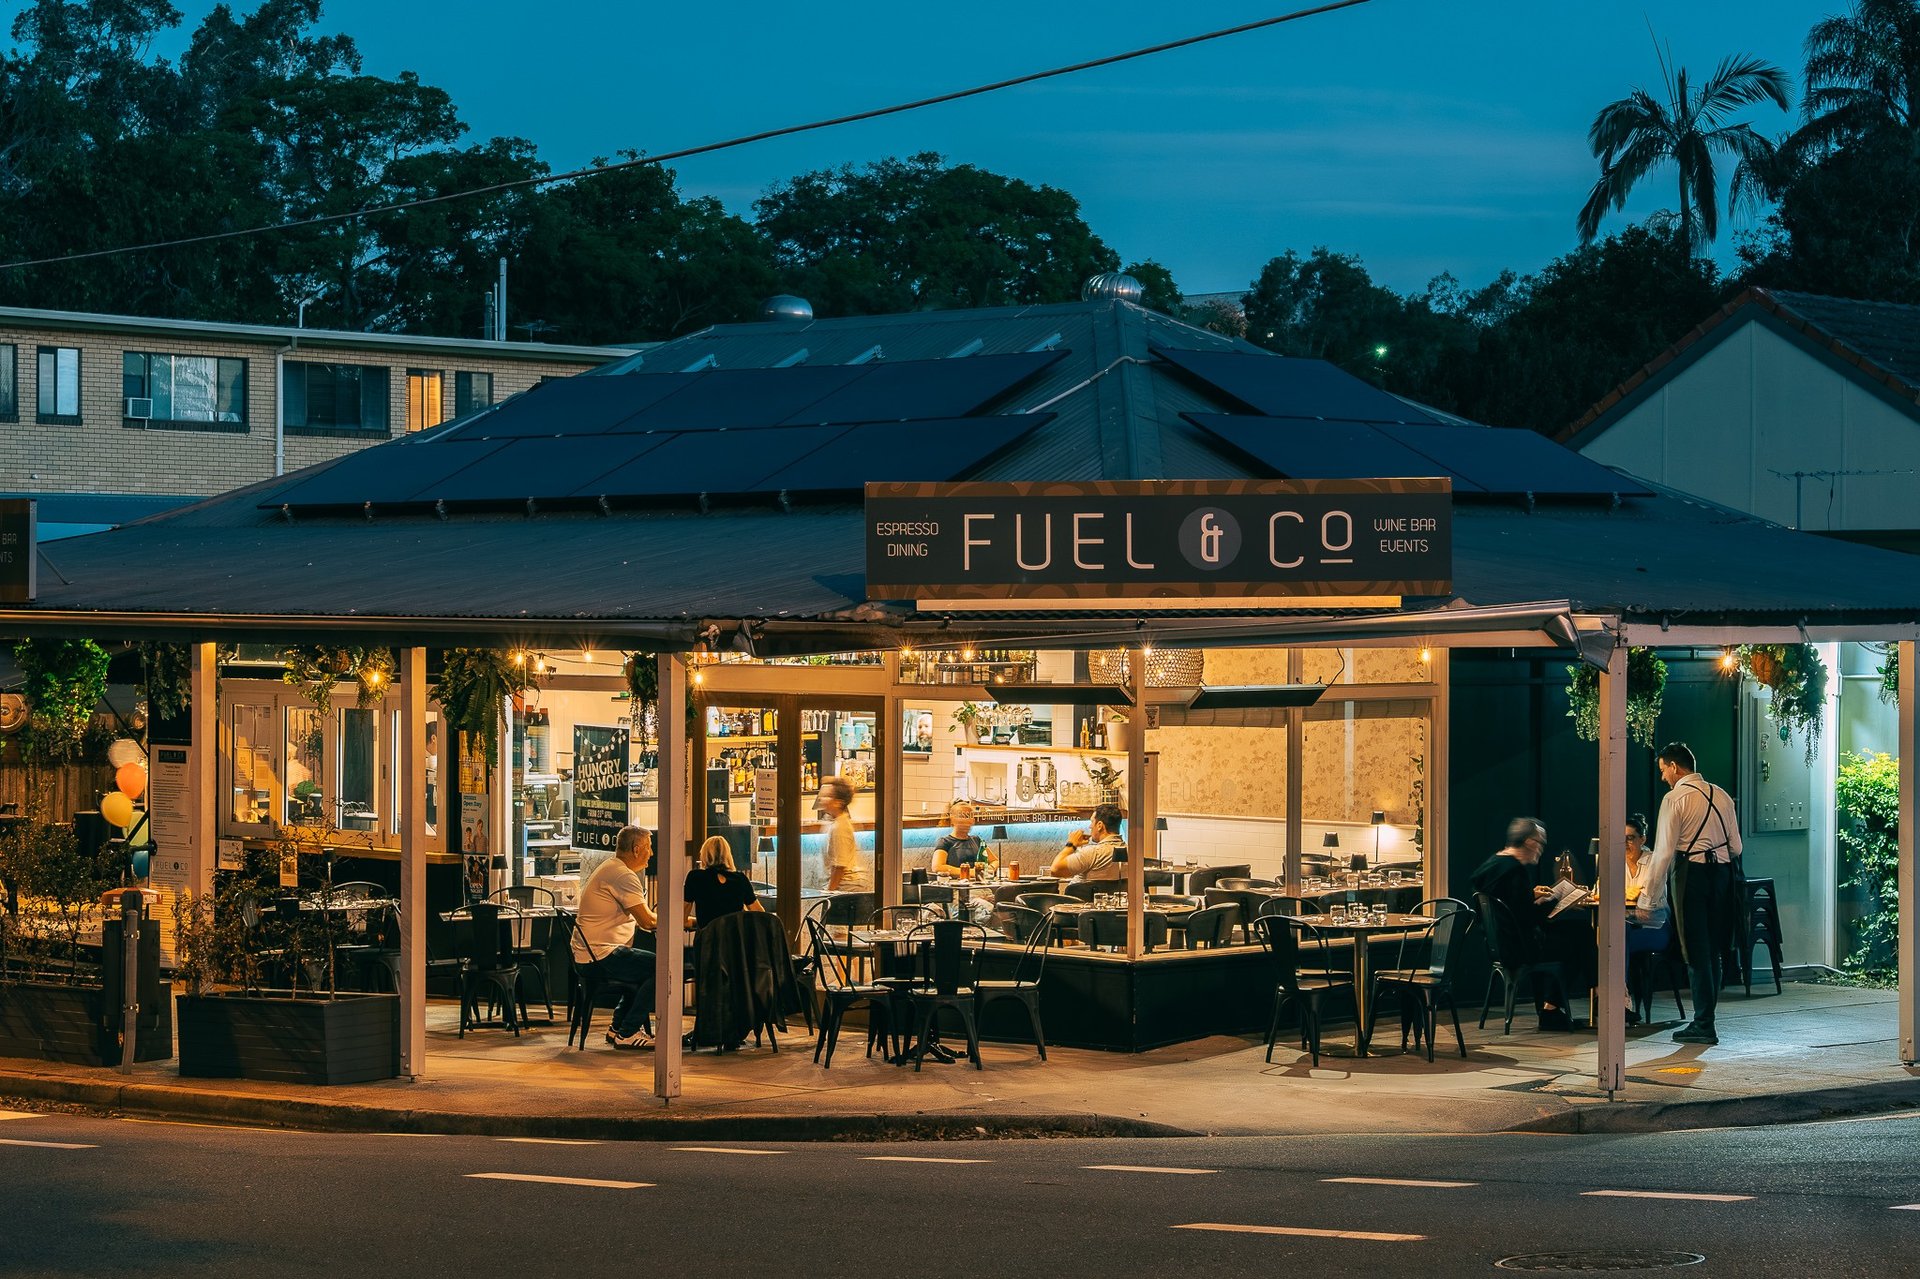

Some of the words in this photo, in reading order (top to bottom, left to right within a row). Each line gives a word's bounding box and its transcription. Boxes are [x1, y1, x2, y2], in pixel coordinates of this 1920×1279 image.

[876, 522, 939, 536] ESPRESSO
[1373, 518, 1407, 532] WINE
[1410, 518, 1436, 532] BAR
[2, 533, 17, 545] BAR
[963, 512, 1156, 571] FUEL
[1200, 512, 1224, 564] &
[1380, 539, 1429, 553] EVENTS
[887, 542, 928, 557] DINING
[577, 758, 621, 779] HUNGRY
[574, 778, 595, 795] FOR
[597, 771, 629, 790] MORE
[952, 776, 1009, 802] FUEL
[1011, 813, 1030, 823] WINE
[576, 831, 600, 845] FUEL
